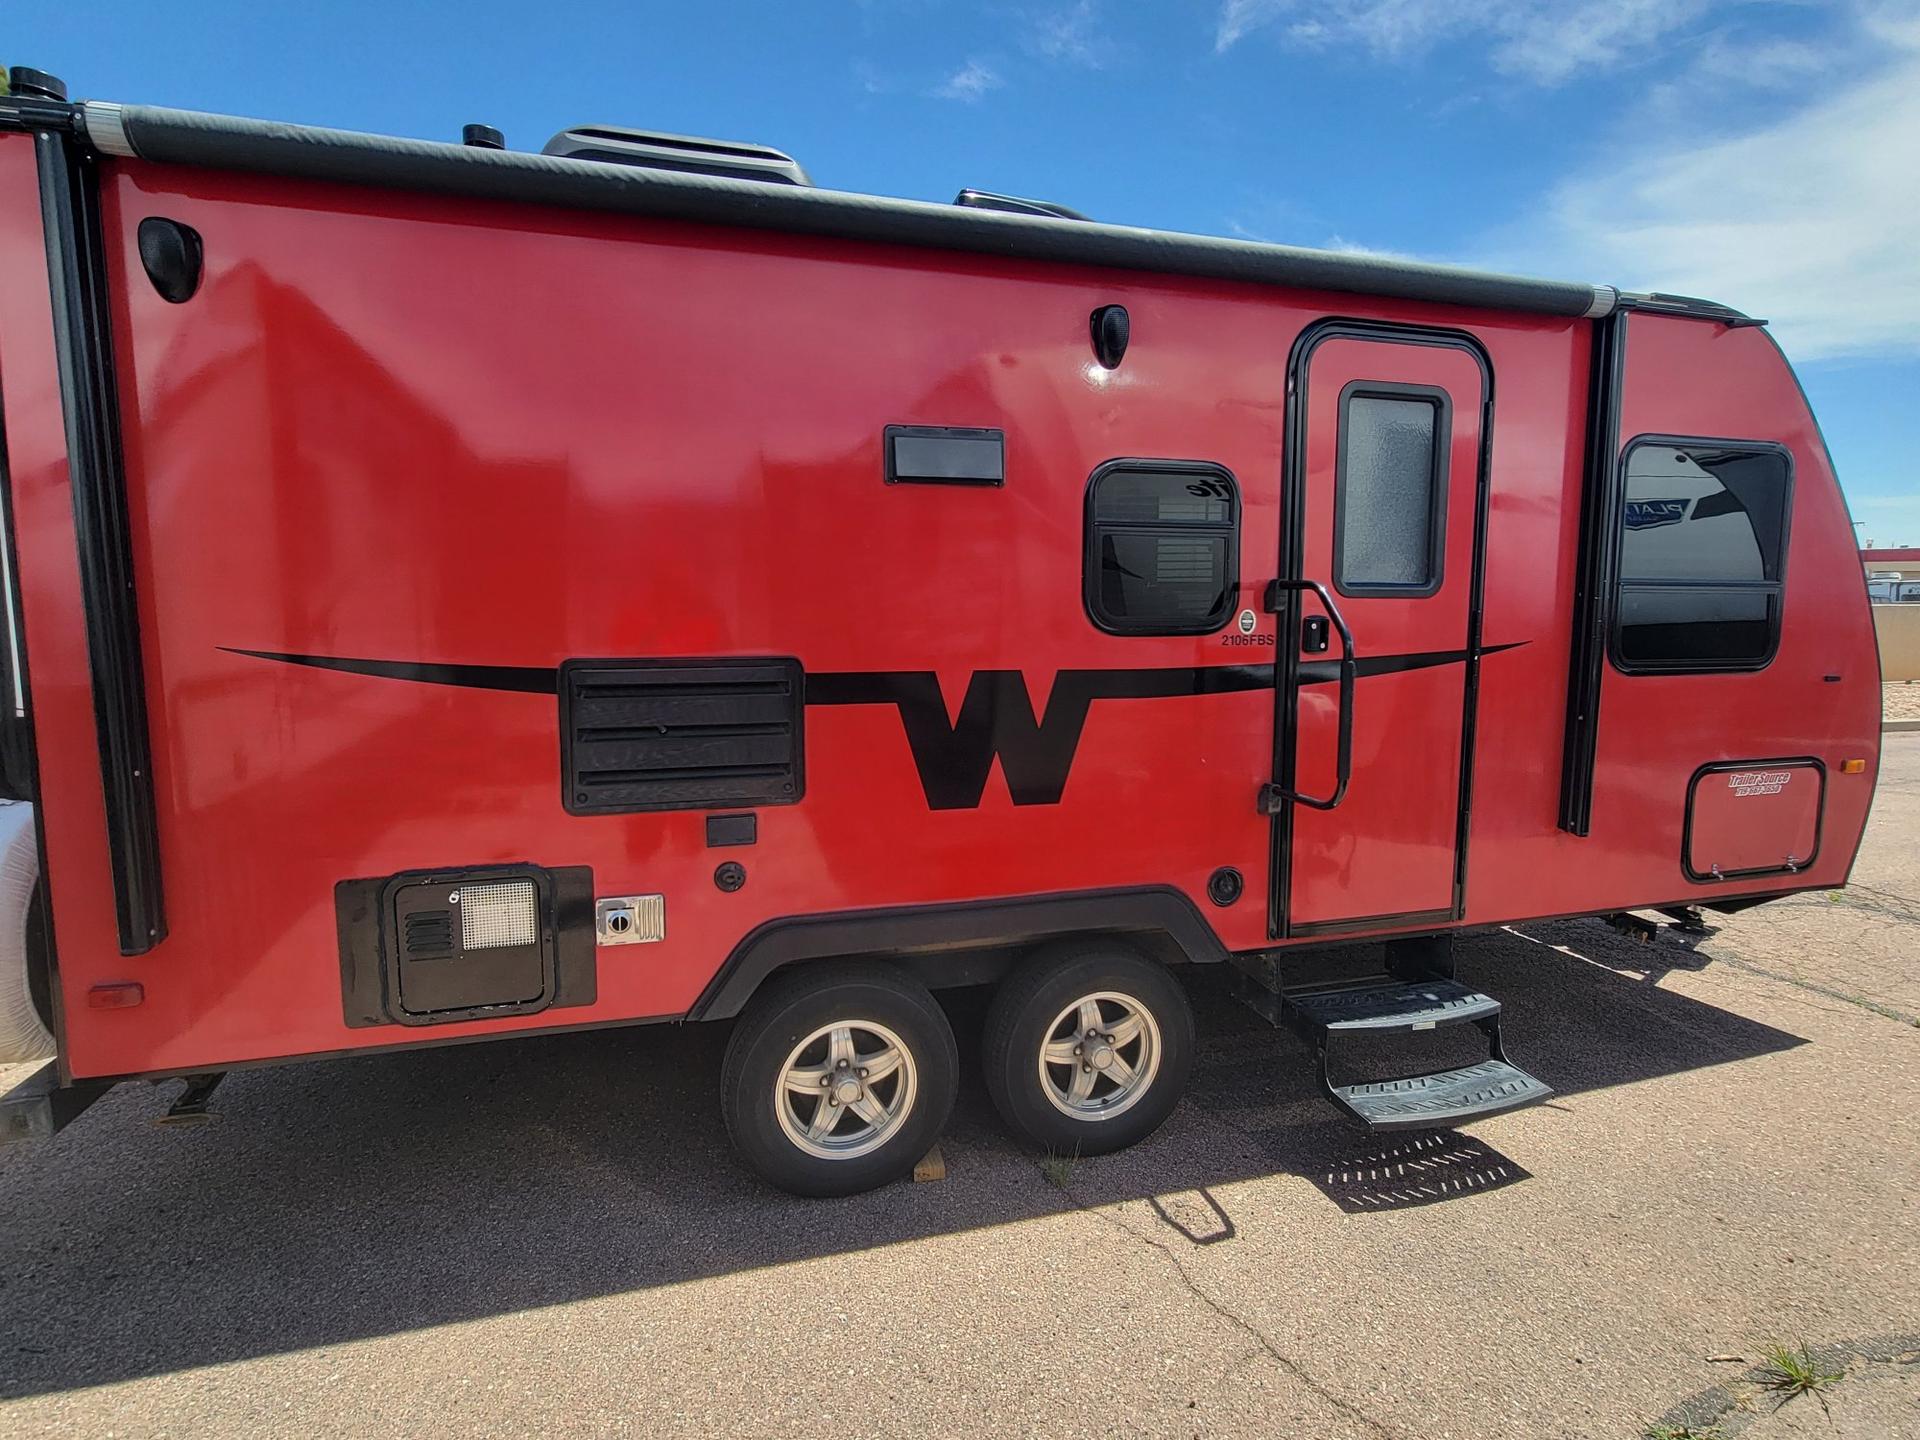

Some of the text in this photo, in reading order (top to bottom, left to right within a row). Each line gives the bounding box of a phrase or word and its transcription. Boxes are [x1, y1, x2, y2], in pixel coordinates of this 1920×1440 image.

[1222, 634, 1275, 646] 2106FBS
[897, 668, 1092, 811] W
[1729, 771, 1790, 787] Trailer Source
